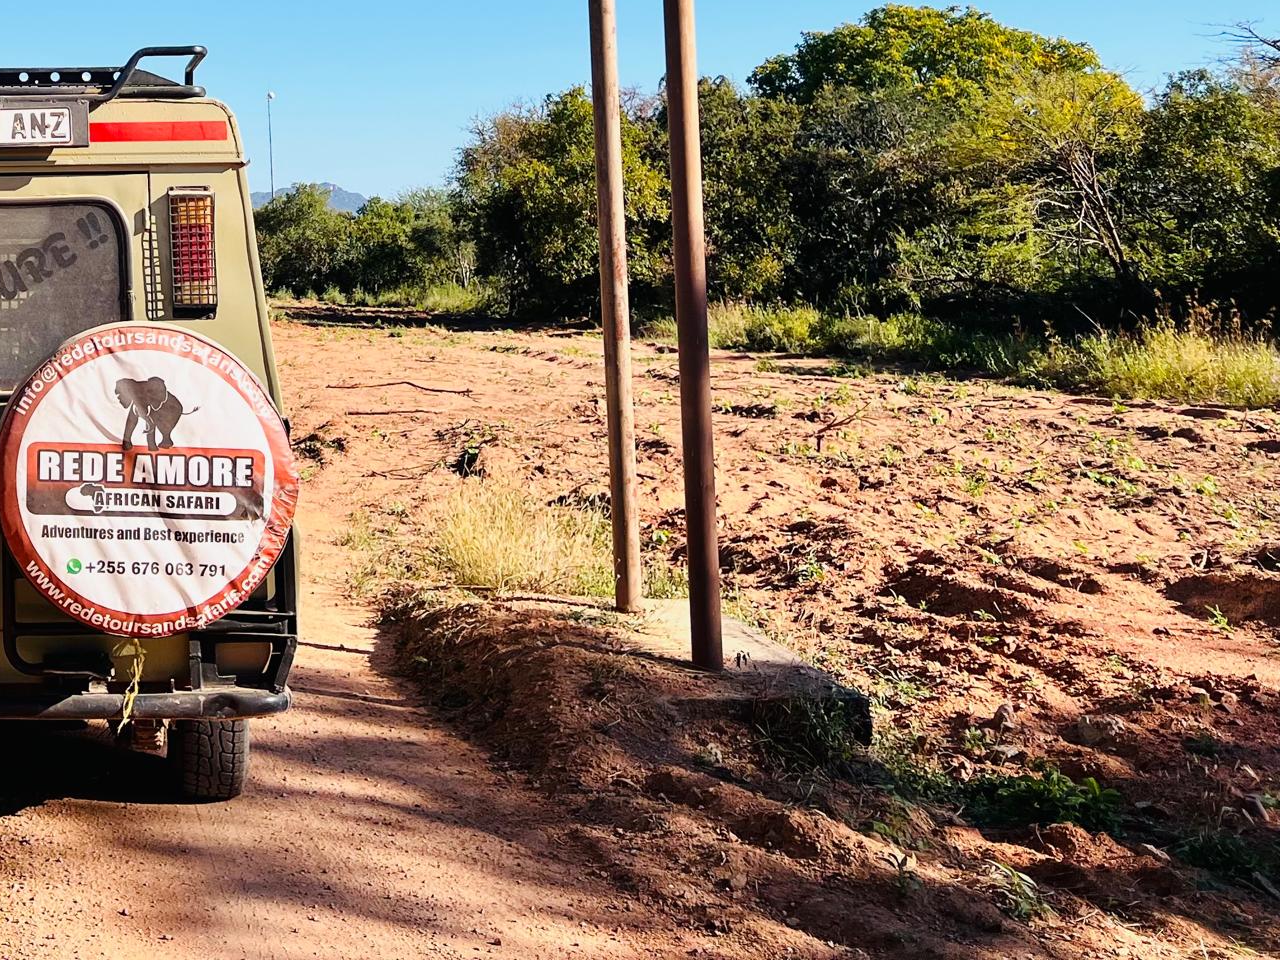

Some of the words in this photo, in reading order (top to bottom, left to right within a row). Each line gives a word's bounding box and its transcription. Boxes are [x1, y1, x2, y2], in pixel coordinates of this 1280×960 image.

[11, 111, 67, 139] ANZ
[38, 451, 124, 483] REDE
[132, 453, 254, 488] AMORE
[94, 491, 161, 508] AFRICAN
[166, 493, 220, 510] SAFARI
[41, 524, 115, 541] Adventures
[116, 527, 141, 541] and
[143, 528, 171, 542] Best
[173, 530, 245, 545] experience
[85, 560, 126, 575] +255
[131, 561, 160, 575] 676
[165, 562, 194, 576] 063
[198, 563, 226, 578] 791
